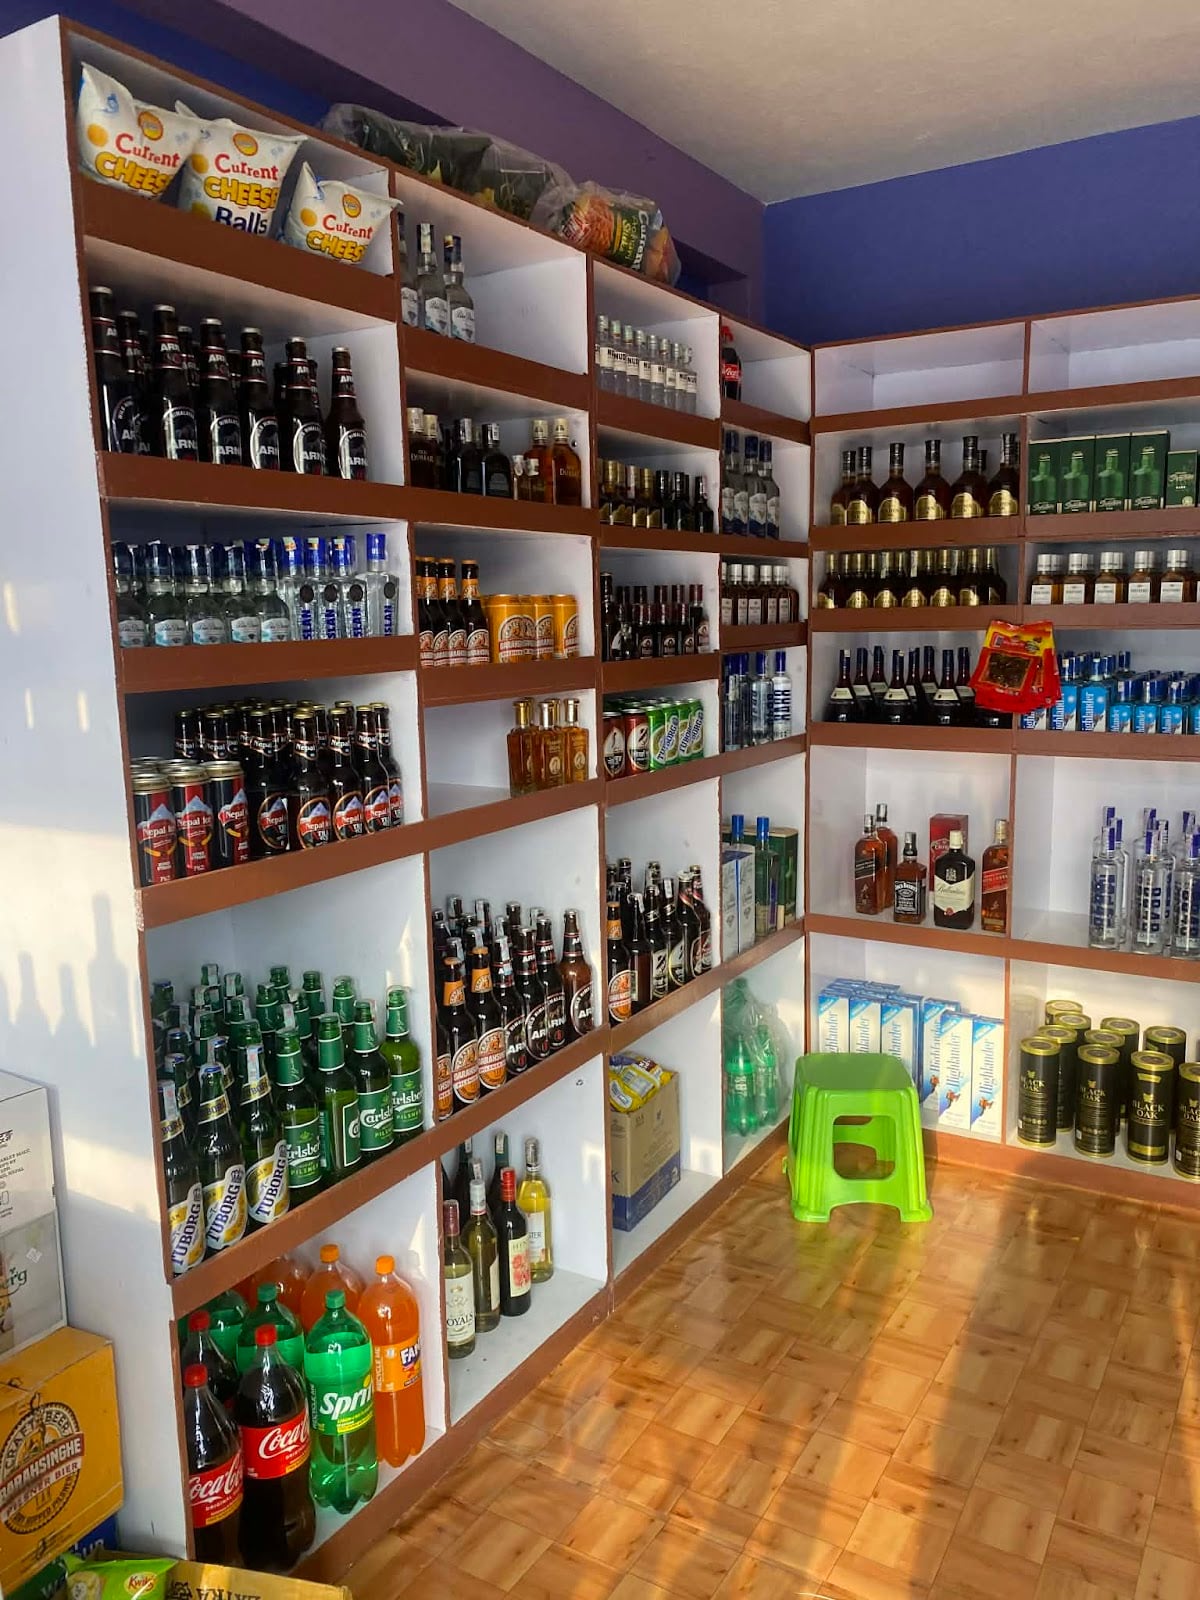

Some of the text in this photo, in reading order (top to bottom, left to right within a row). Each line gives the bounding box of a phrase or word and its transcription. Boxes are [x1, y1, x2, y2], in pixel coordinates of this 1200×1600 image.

[115, 132, 181, 168] Current
[214, 153, 278, 181] Current
[216, 206, 267, 235] Balls
[322, 214, 373, 241] Current
[142, 827, 166, 838] Nepal
[1136, 1110, 1159, 1120] OAK
[255, 1158, 286, 1216] TUBORG
[205, 1182, 242, 1244] TUBORG
[171, 1203, 201, 1266] TUBORG
[45, 1410, 71, 1436] BEER
[54, 1462, 78, 1480] BIER
